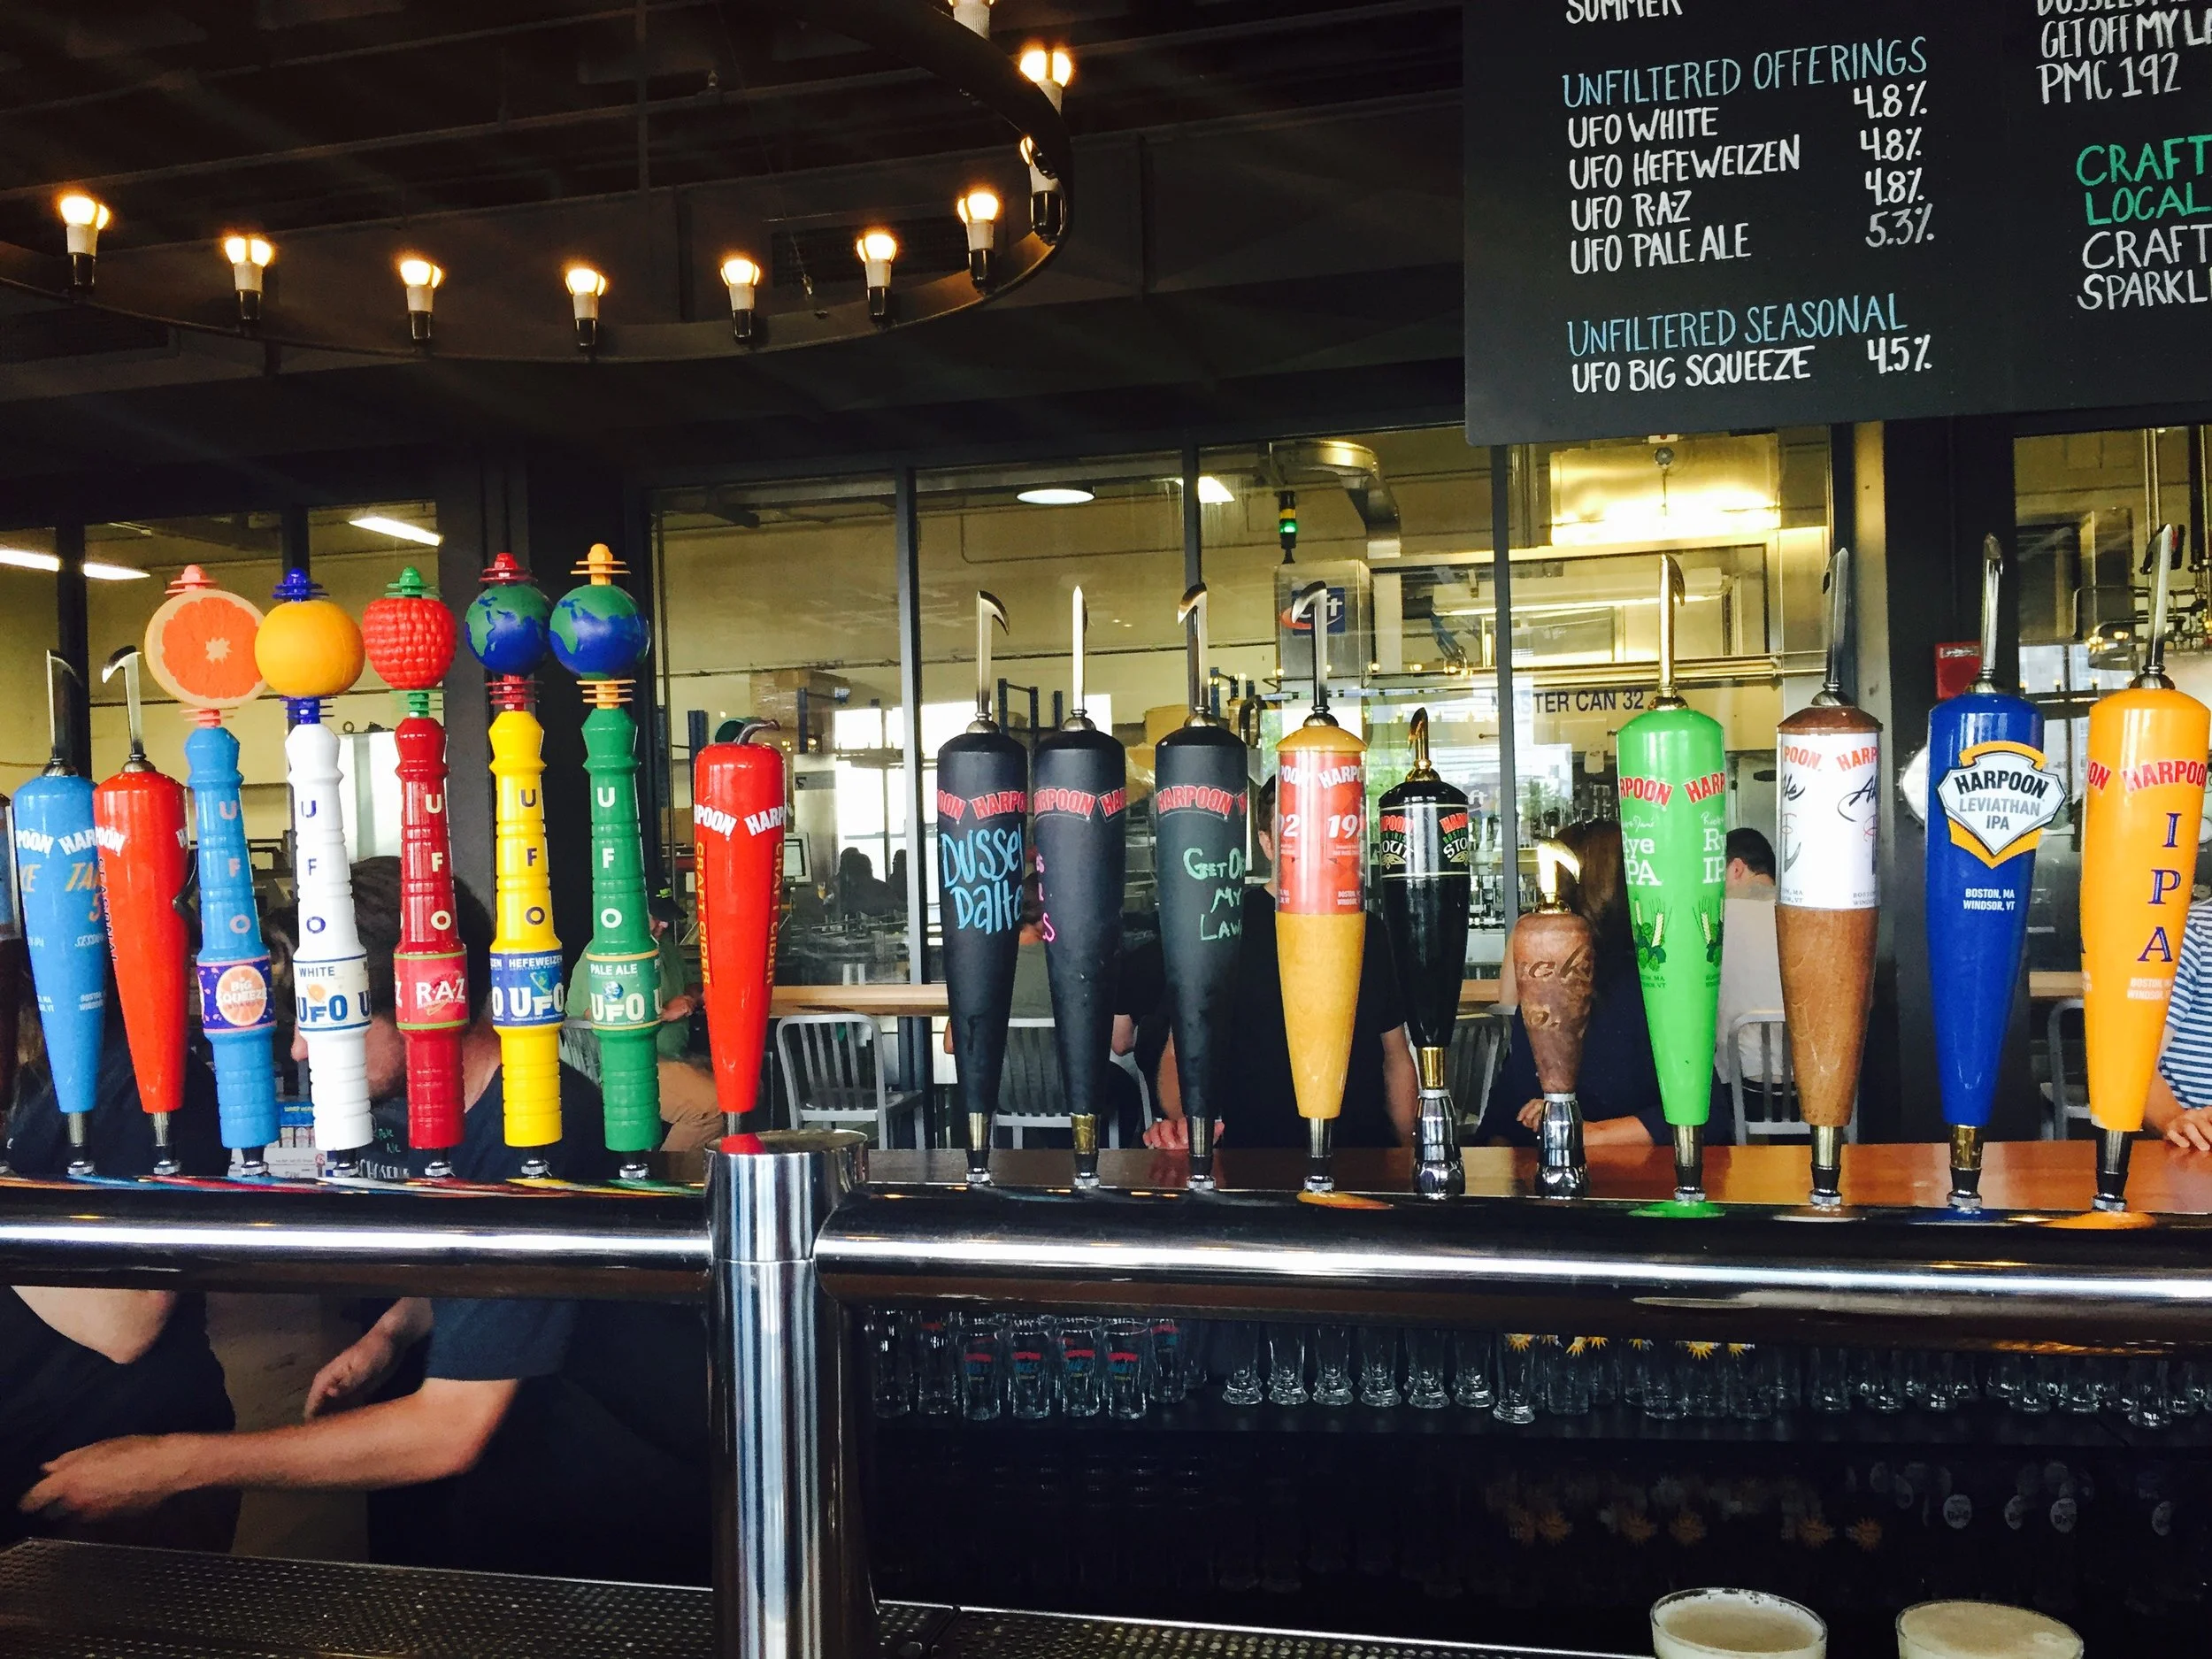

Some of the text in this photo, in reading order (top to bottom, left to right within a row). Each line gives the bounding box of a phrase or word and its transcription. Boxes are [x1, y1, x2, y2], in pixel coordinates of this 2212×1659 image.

[2041, 18, 2085, 58] GET
[2088, 13, 2131, 56] OFF
[2136, 8, 2179, 51] MY
[1562, 36, 1927, 108] UNFILTERED OFFERINGS
[2036, 51, 2182, 104] PMC 192
[1569, 81, 1928, 148] UFO WHITE 4.8%
[1570, 127, 1922, 190] UFO HEFEWEIZEN 4.8%
[2076, 134, 2212, 186] CRAFT
[1571, 195, 1622, 231] UFO
[1865, 167, 1924, 205] 4.8%
[2085, 181, 2212, 226] LOCAL
[1571, 203, 1935, 274] UFO PALE ALE 5.3%
[2082, 223, 2212, 269] CRAFT
[2078, 267, 2212, 310] SPARKL
[1567, 293, 1909, 357] UNFILTERED SEASONAL
[1571, 334, 1932, 393] UFO BIG SQUEEZE 4.5%
[1575, 688, 1617, 712] CAN
[1622, 688, 1645, 711] 32
[1156, 784, 1234, 816] HARPOON
[1954, 769, 2049, 799] HARPOON
[937, 788, 966, 820] OON
[1958, 797, 2041, 817] LEVIATHAN
[1279, 813, 1301, 837] 2
[1327, 813, 1361, 841] 19
[1985, 814, 2010, 830] IPA
[1381, 840, 1415, 860] OUT
[65, 862, 101, 892] TA
[1624, 858, 1663, 886] PA
[1962, 900, 2016, 911] WINDSOR, VT
[1965, 887, 2015, 900] BOSTON, MA
[695, 841, 710, 985] CRAFT CIDER
[766, 842, 783, 985] CRAFT CIDER
[299, 966, 334, 977] WHITE
[509, 955, 563, 968] HEFEWEIZEN
[590, 963, 638, 976] PALE ALE
[297, 995, 349, 1023] UFO
[508, 982, 565, 1018] UFO
[590, 992, 646, 1022] UFO
